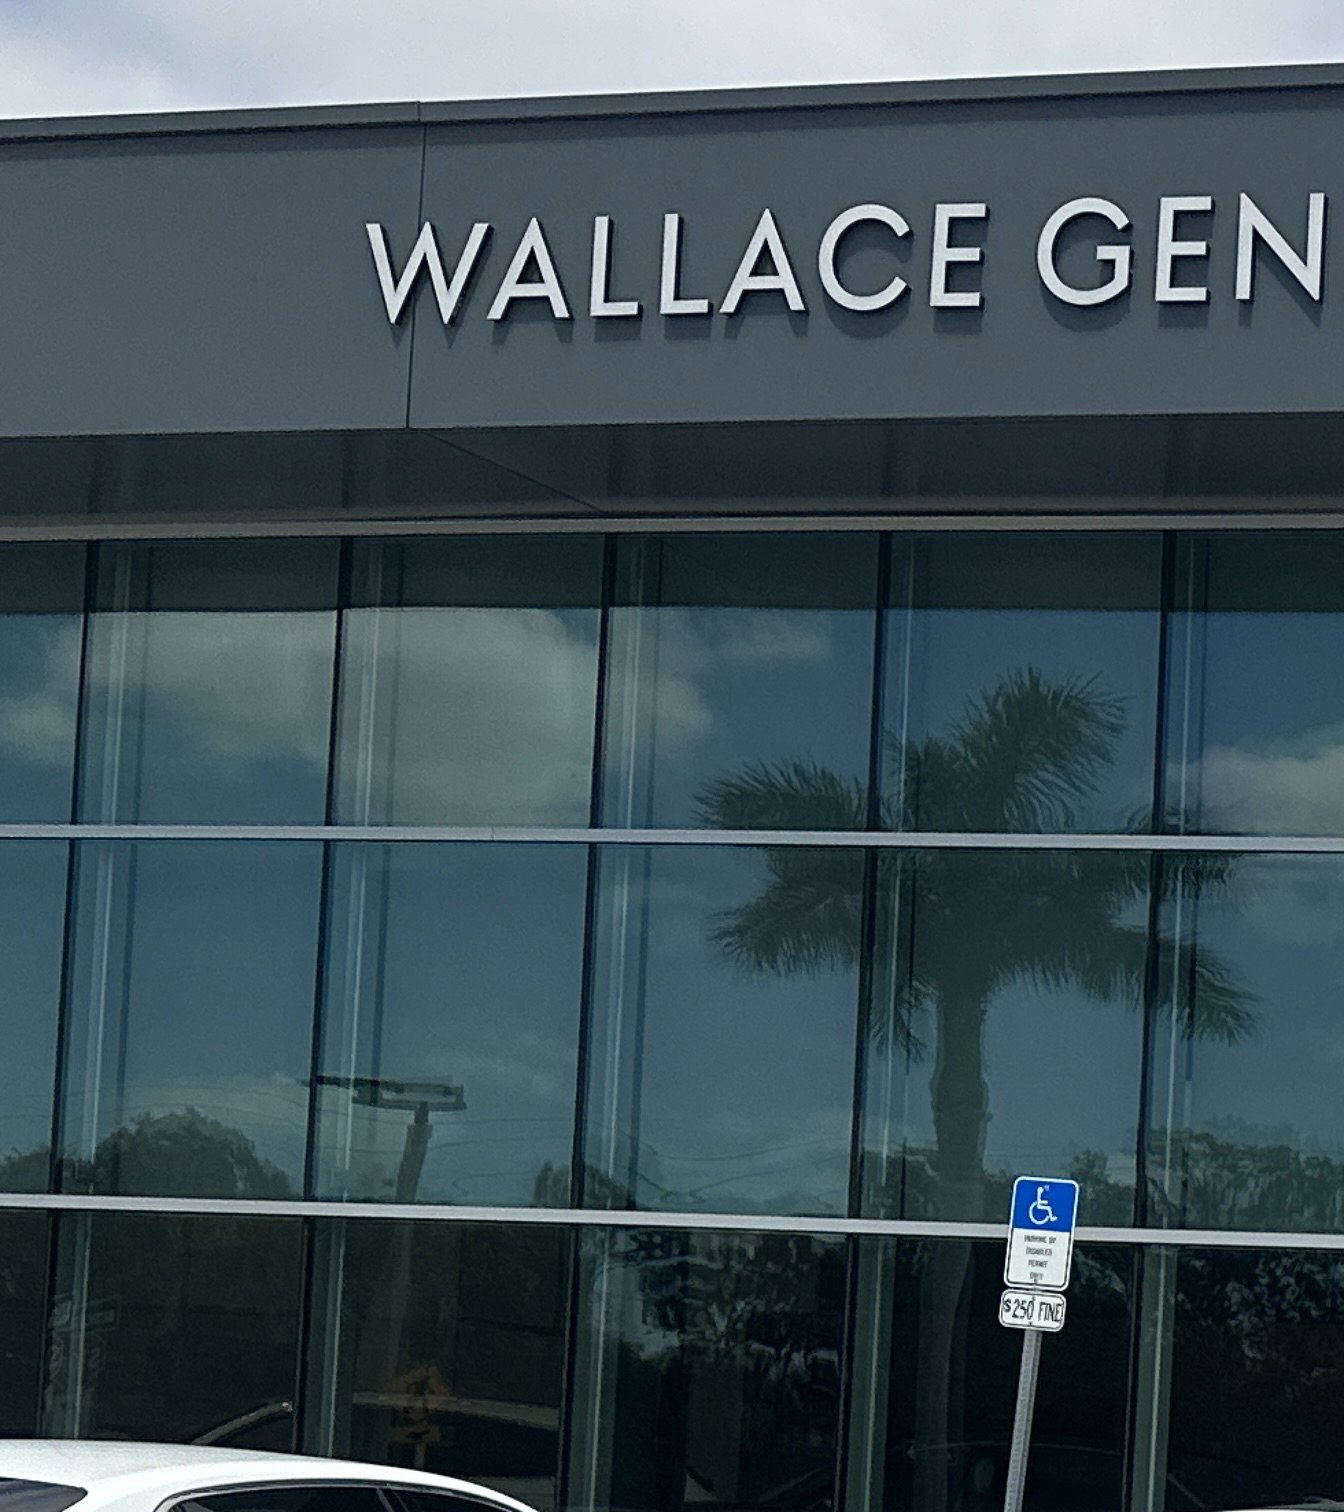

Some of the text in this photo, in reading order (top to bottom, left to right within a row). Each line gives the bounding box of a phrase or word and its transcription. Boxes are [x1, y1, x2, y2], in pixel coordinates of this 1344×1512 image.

[364, 202, 986, 325] WALLACE
[1004, 1299, 1063, 1323] $250 FINE
